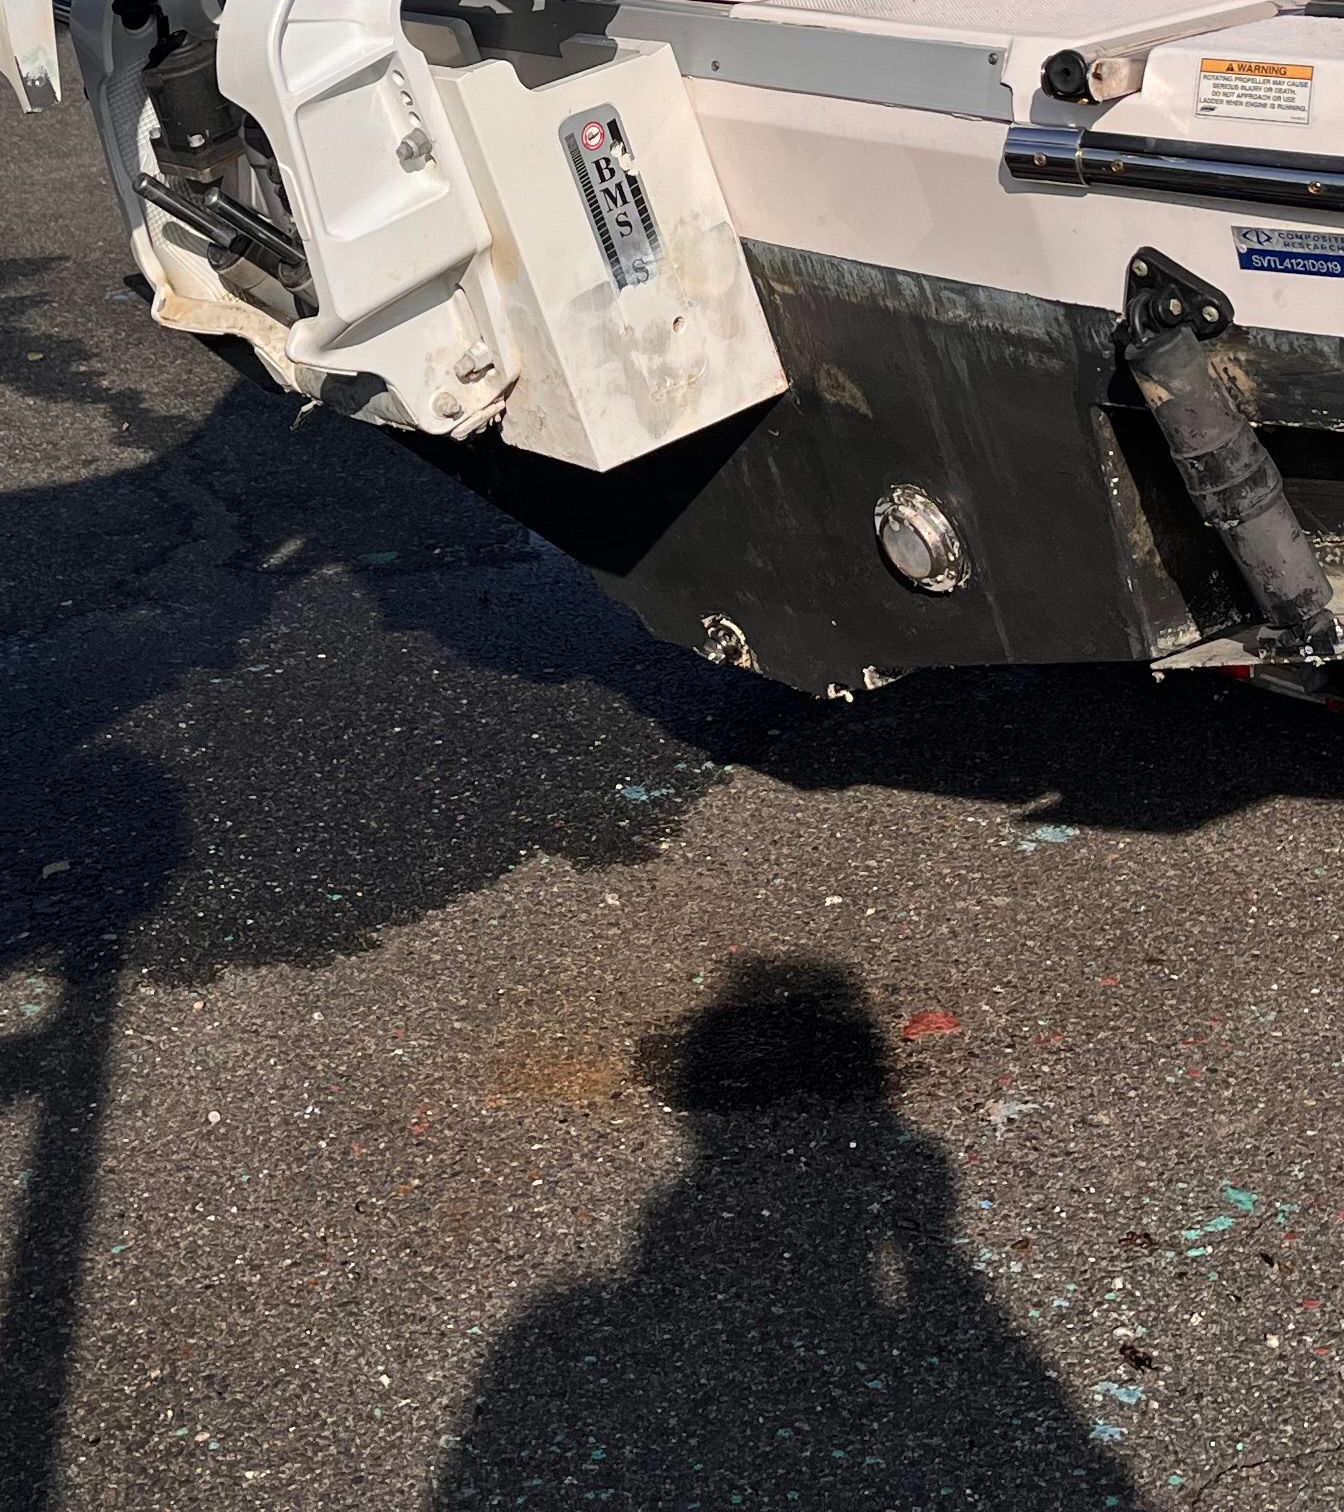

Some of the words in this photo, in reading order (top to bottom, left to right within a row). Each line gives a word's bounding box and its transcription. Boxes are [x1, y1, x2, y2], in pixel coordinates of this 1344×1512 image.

[1237, 63, 1287, 76] WARNING
[1212, 82, 1239, 90] SERIOUS
[1234, 76, 1271, 85] PROPELLER
[1286, 80, 1308, 88] CAUSE
[1251, 254, 1342, 274] SVTL4121D919
